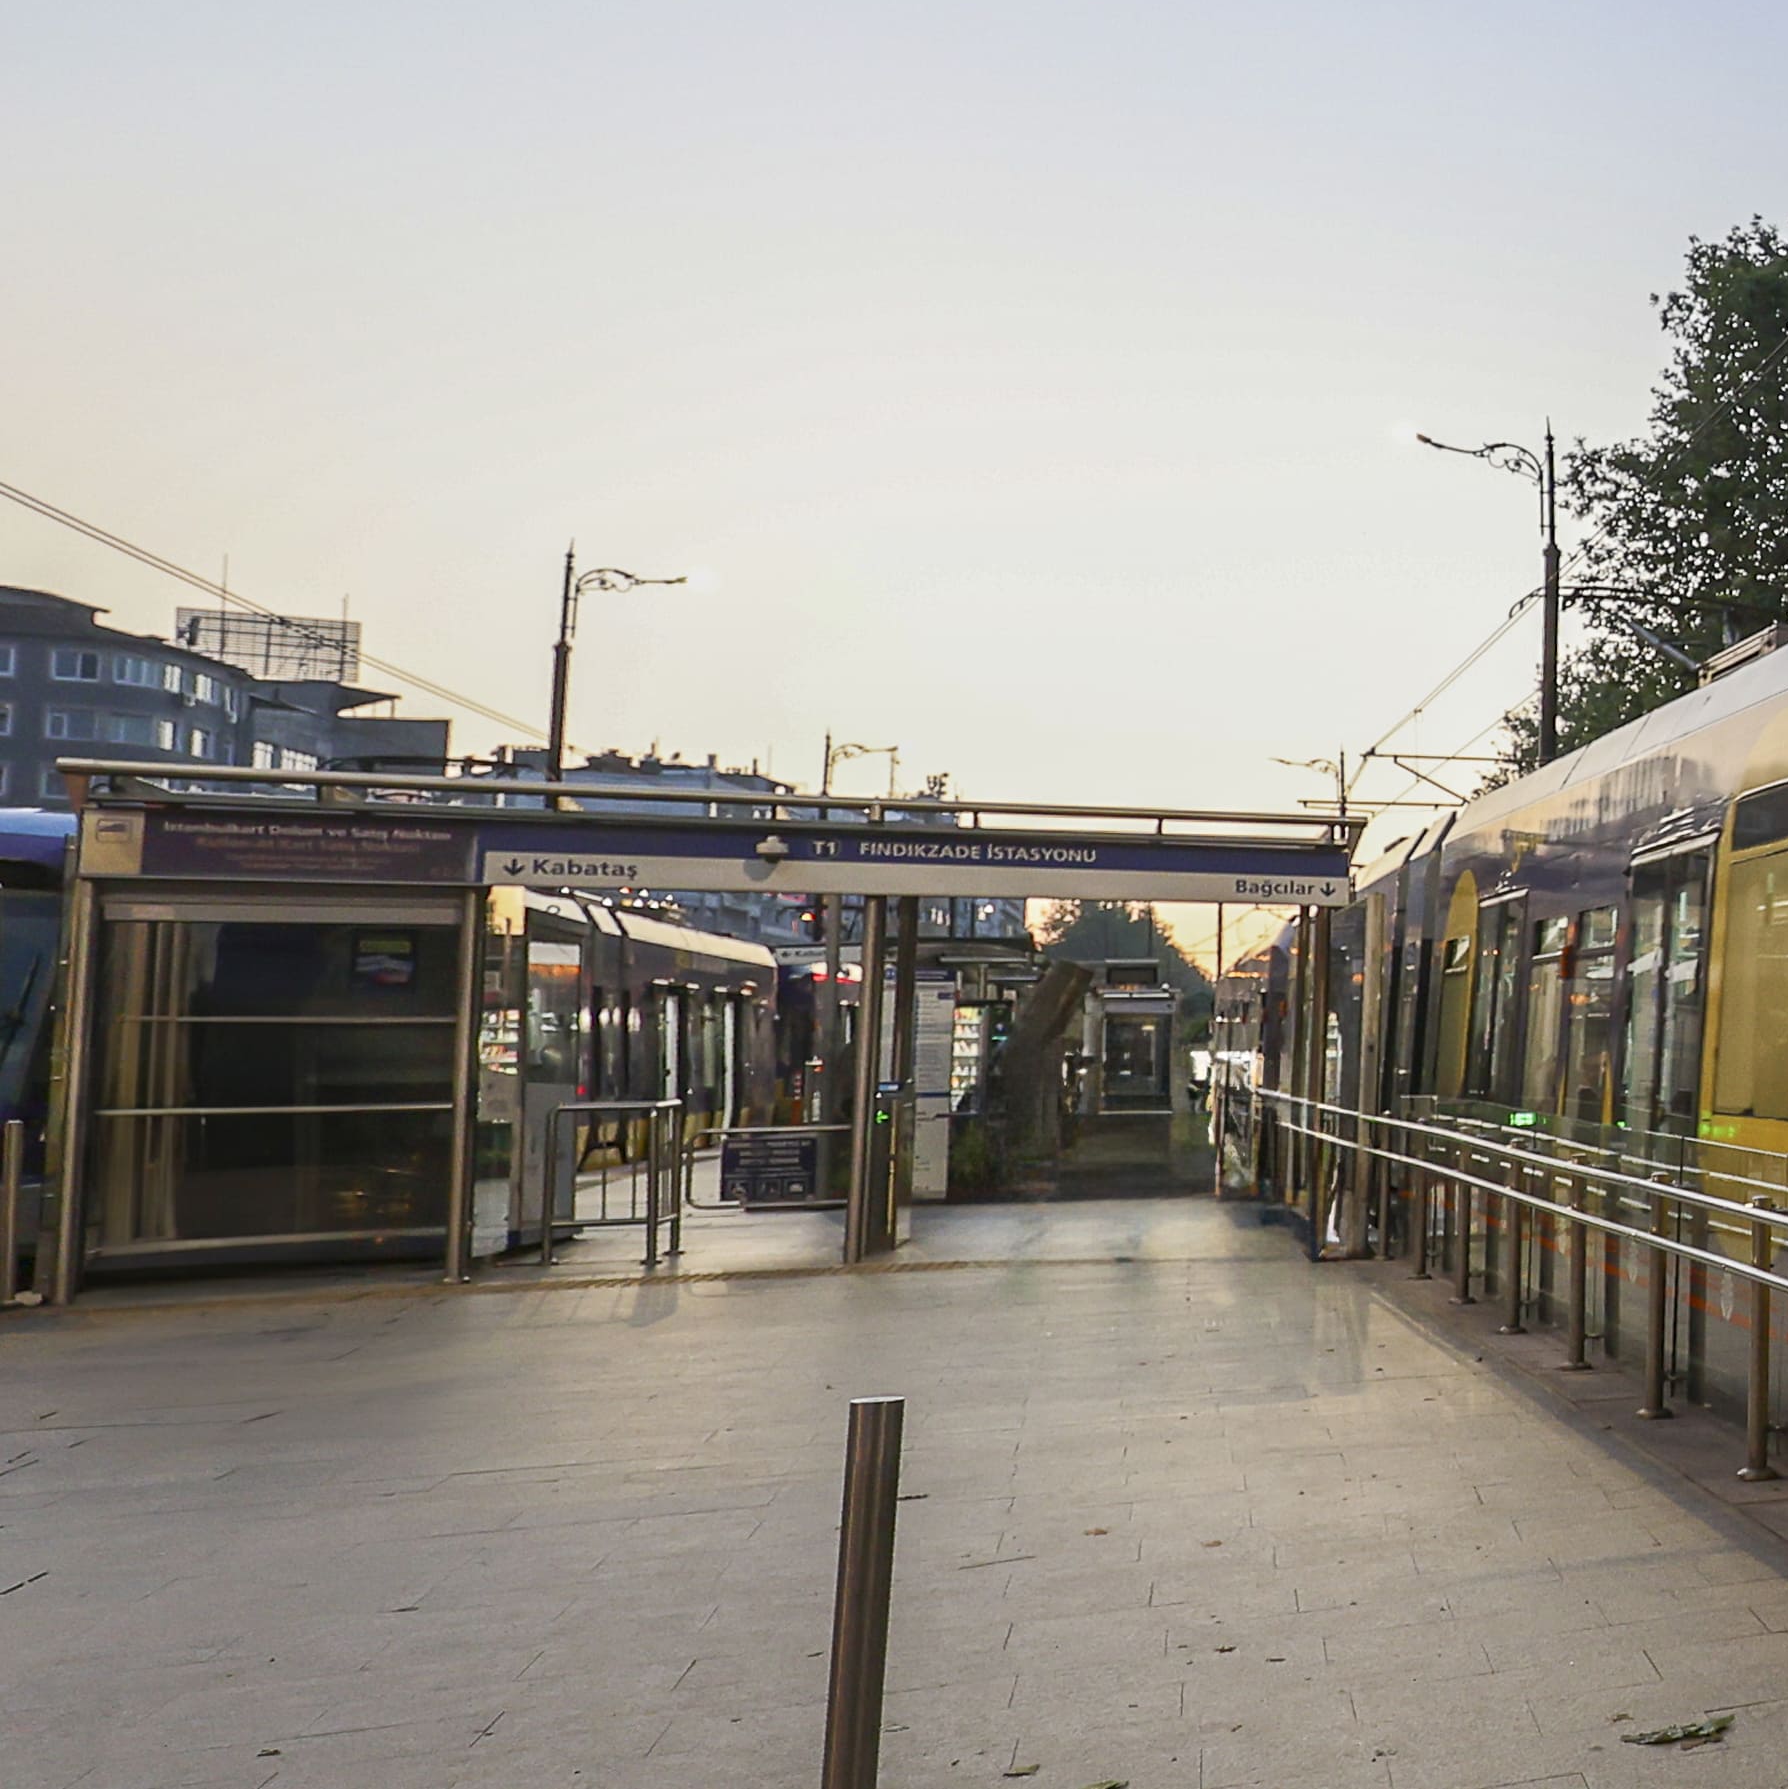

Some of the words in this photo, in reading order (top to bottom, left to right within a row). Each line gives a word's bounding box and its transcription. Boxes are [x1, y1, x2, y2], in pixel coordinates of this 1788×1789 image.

[813, 840, 836, 855] T1
[859, 841, 980, 860] FINDIKZADE
[987, 842, 1097, 862] İSTASYONU
[531, 858, 638, 881] Kabataş
[1235, 879, 1315, 898] Bağcılar
